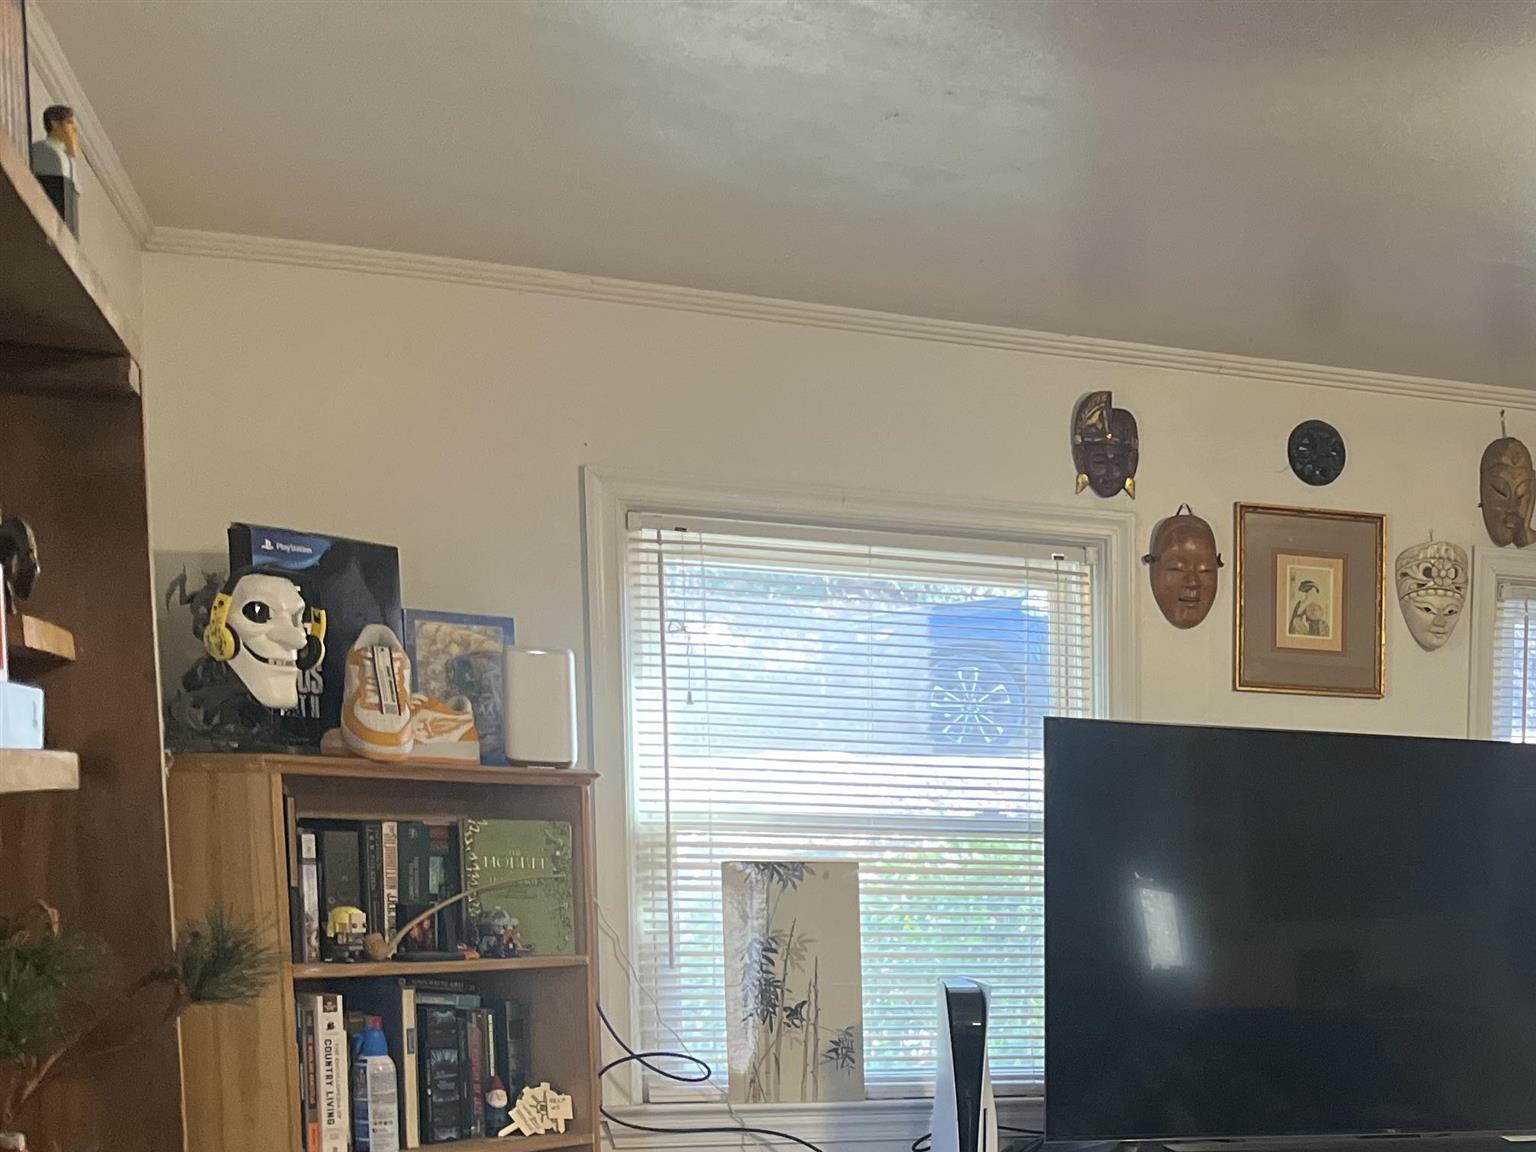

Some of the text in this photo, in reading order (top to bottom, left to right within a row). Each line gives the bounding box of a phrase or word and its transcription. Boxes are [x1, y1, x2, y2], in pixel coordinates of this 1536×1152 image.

[276, 542, 312, 555] PlayStation
[322, 1038, 336, 1126] COUNTRY LIVING
